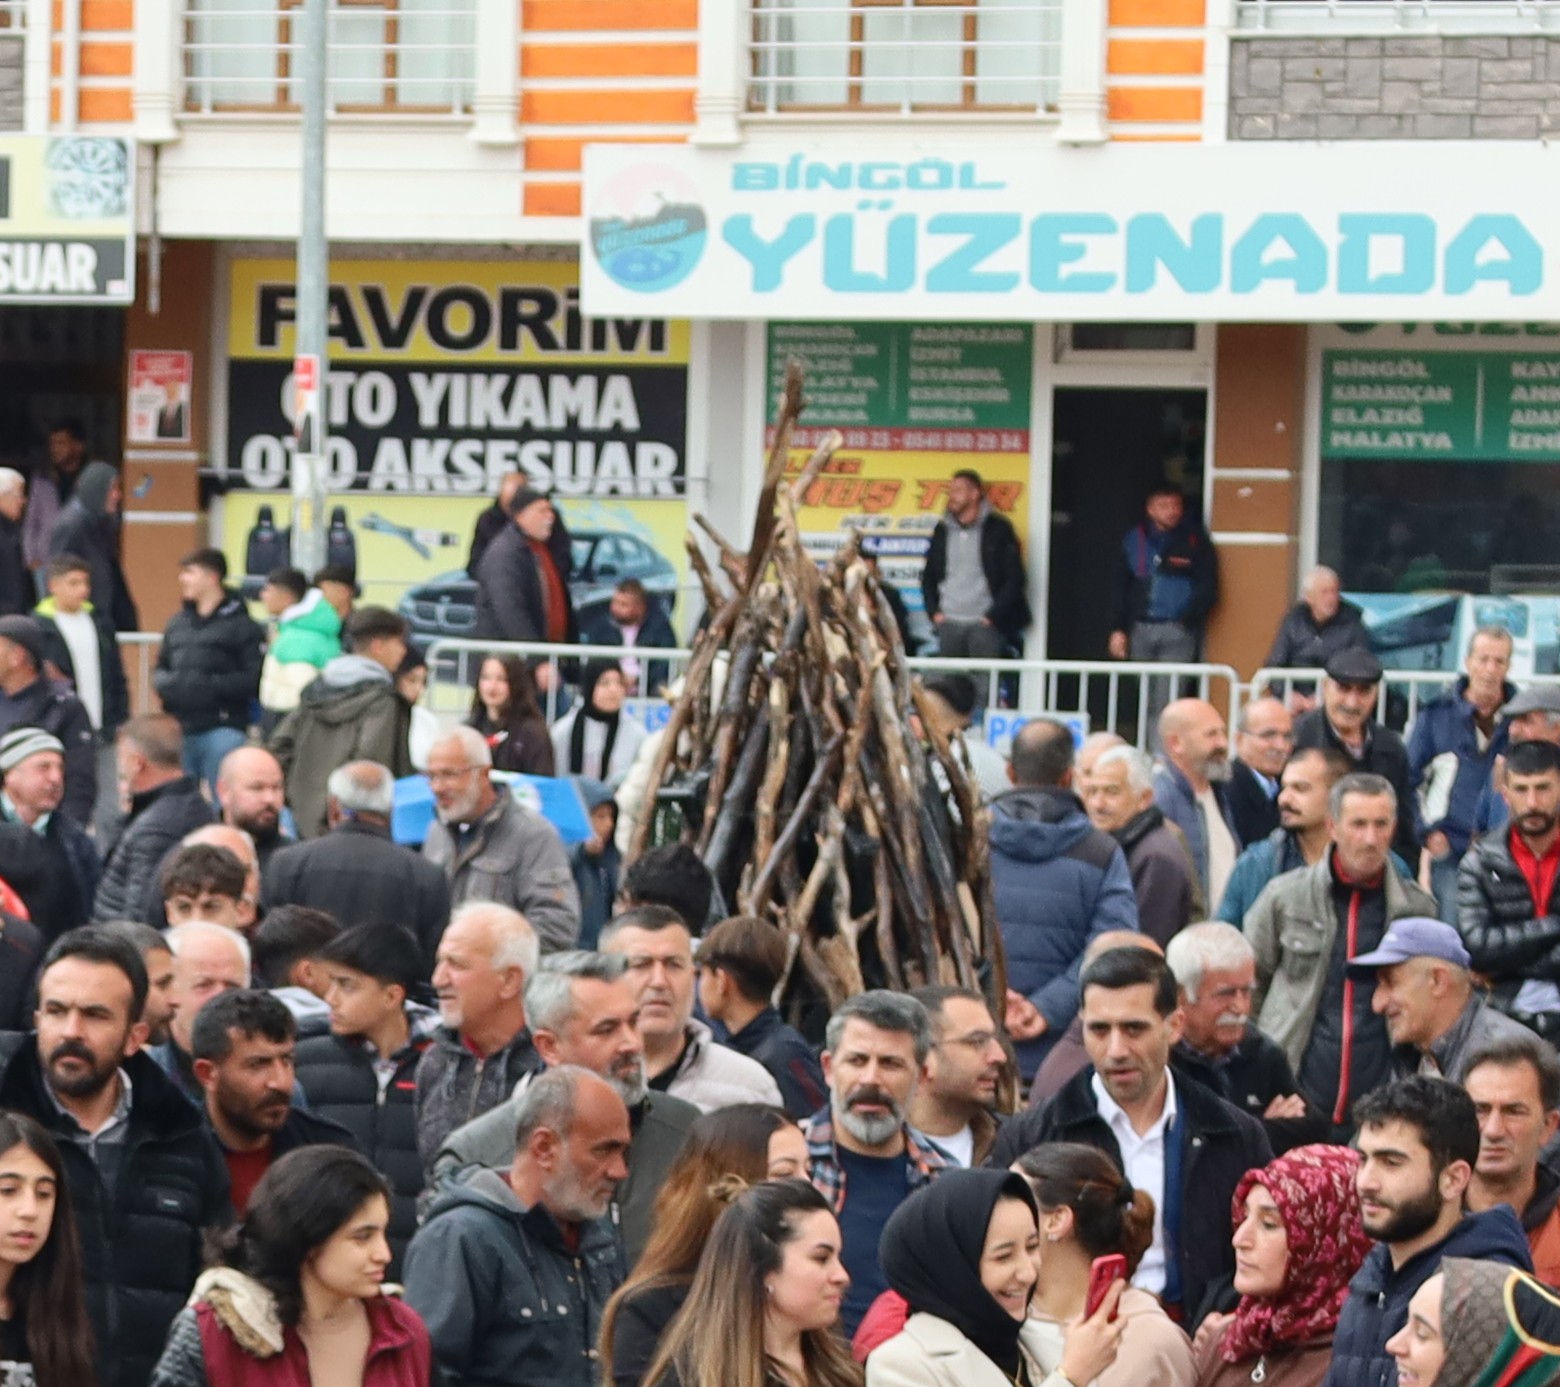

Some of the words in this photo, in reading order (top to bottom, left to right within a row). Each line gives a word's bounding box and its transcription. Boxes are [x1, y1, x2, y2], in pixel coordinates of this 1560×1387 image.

[730, 153, 1007, 190] BİNGÖL
[722, 200, 1544, 294] YÜZENADA
[1332, 360, 1431, 379] BİNGÖL
[409, 372, 641, 431] YIKAMA
[1330, 431, 1454, 450] MALATYA
[241, 435, 358, 489] OO
[369, 437, 680, 495] AKSESUAR
